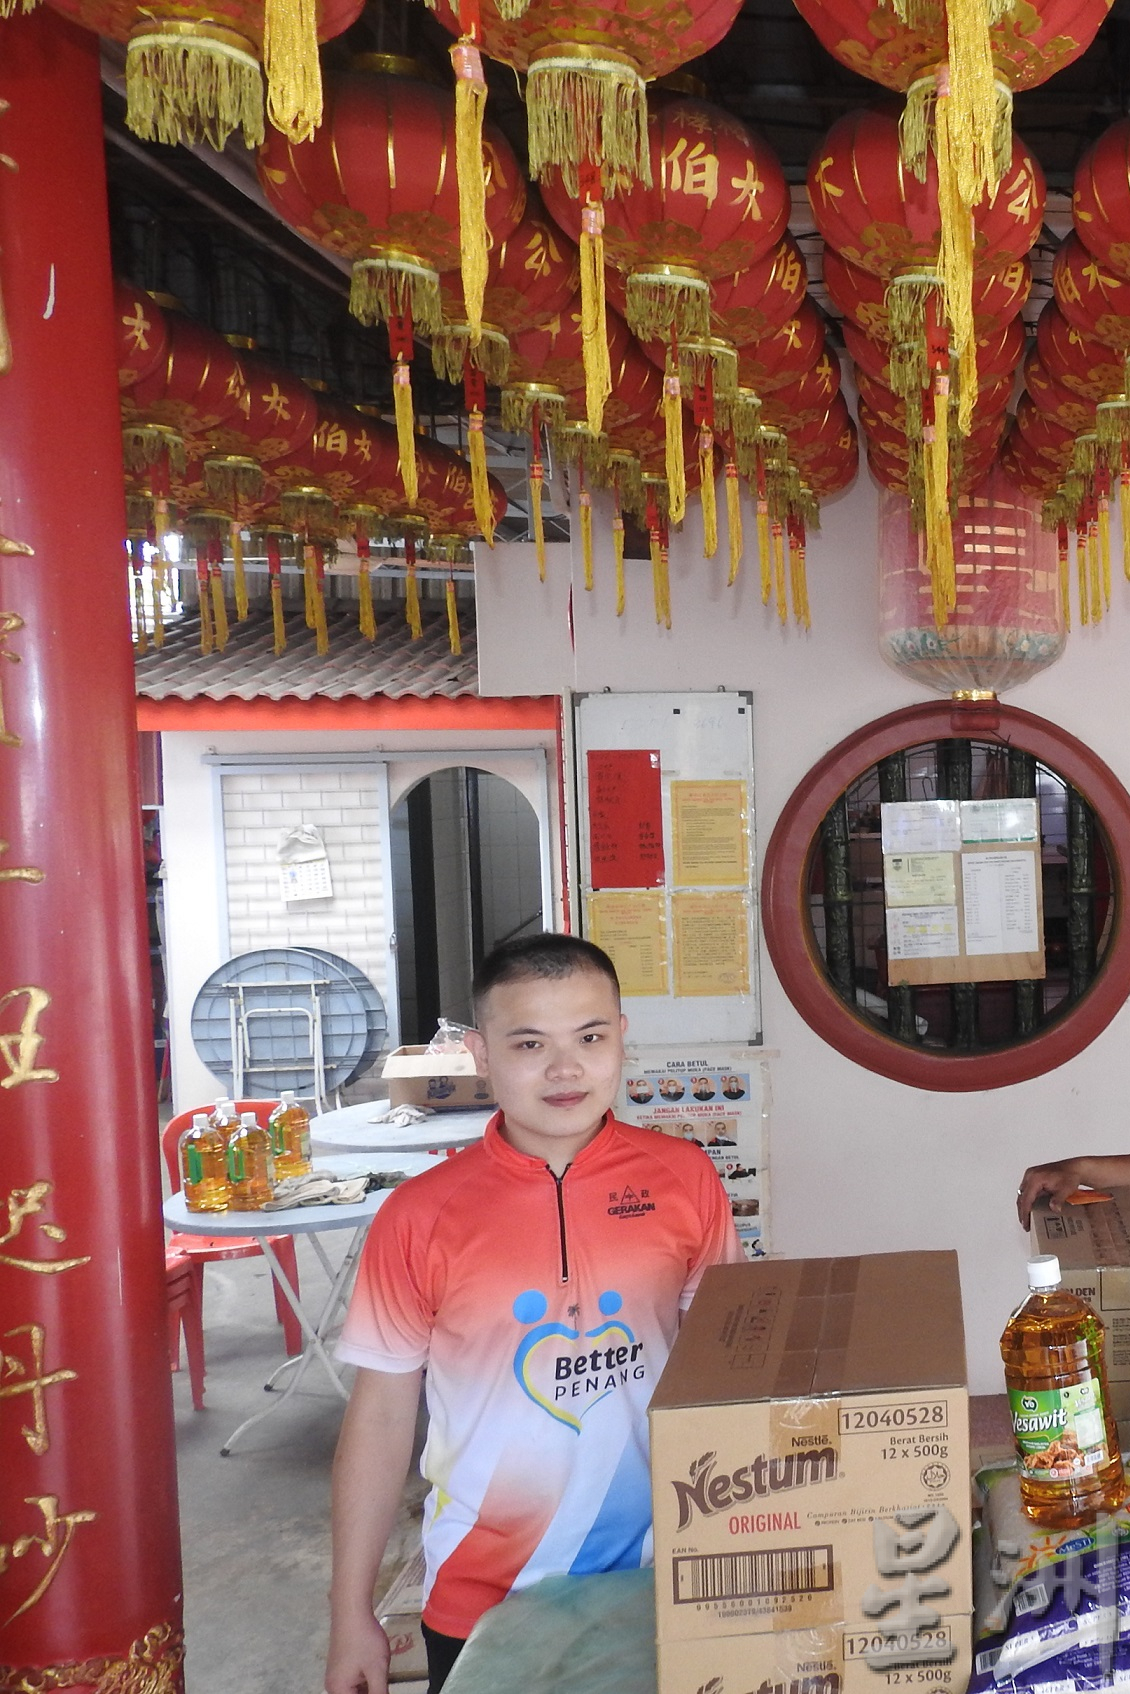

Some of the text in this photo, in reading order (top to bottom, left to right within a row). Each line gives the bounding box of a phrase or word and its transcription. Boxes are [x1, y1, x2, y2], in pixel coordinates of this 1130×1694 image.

[653, 1106, 680, 1114] JANGAN
[607, 1202, 656, 1216] GERAKAN
[555, 1343, 644, 1381] Better
[554, 1364, 646, 1401] PENANG
[841, 1405, 944, 1430] 12040528
[890, 1432, 949, 1446] Berat Bersih
[881, 1443, 950, 1460] 12 x 500g
[670, 1446, 839, 1533] Nestum
[728, 1511, 802, 1535] ORIGINAL
[806, 1510, 848, 1520] Campuran
[850, 1507, 876, 1517] Bijirin
[846, 1630, 947, 1656] 12040528
[885, 1669, 952, 1685] 12 x 500g
